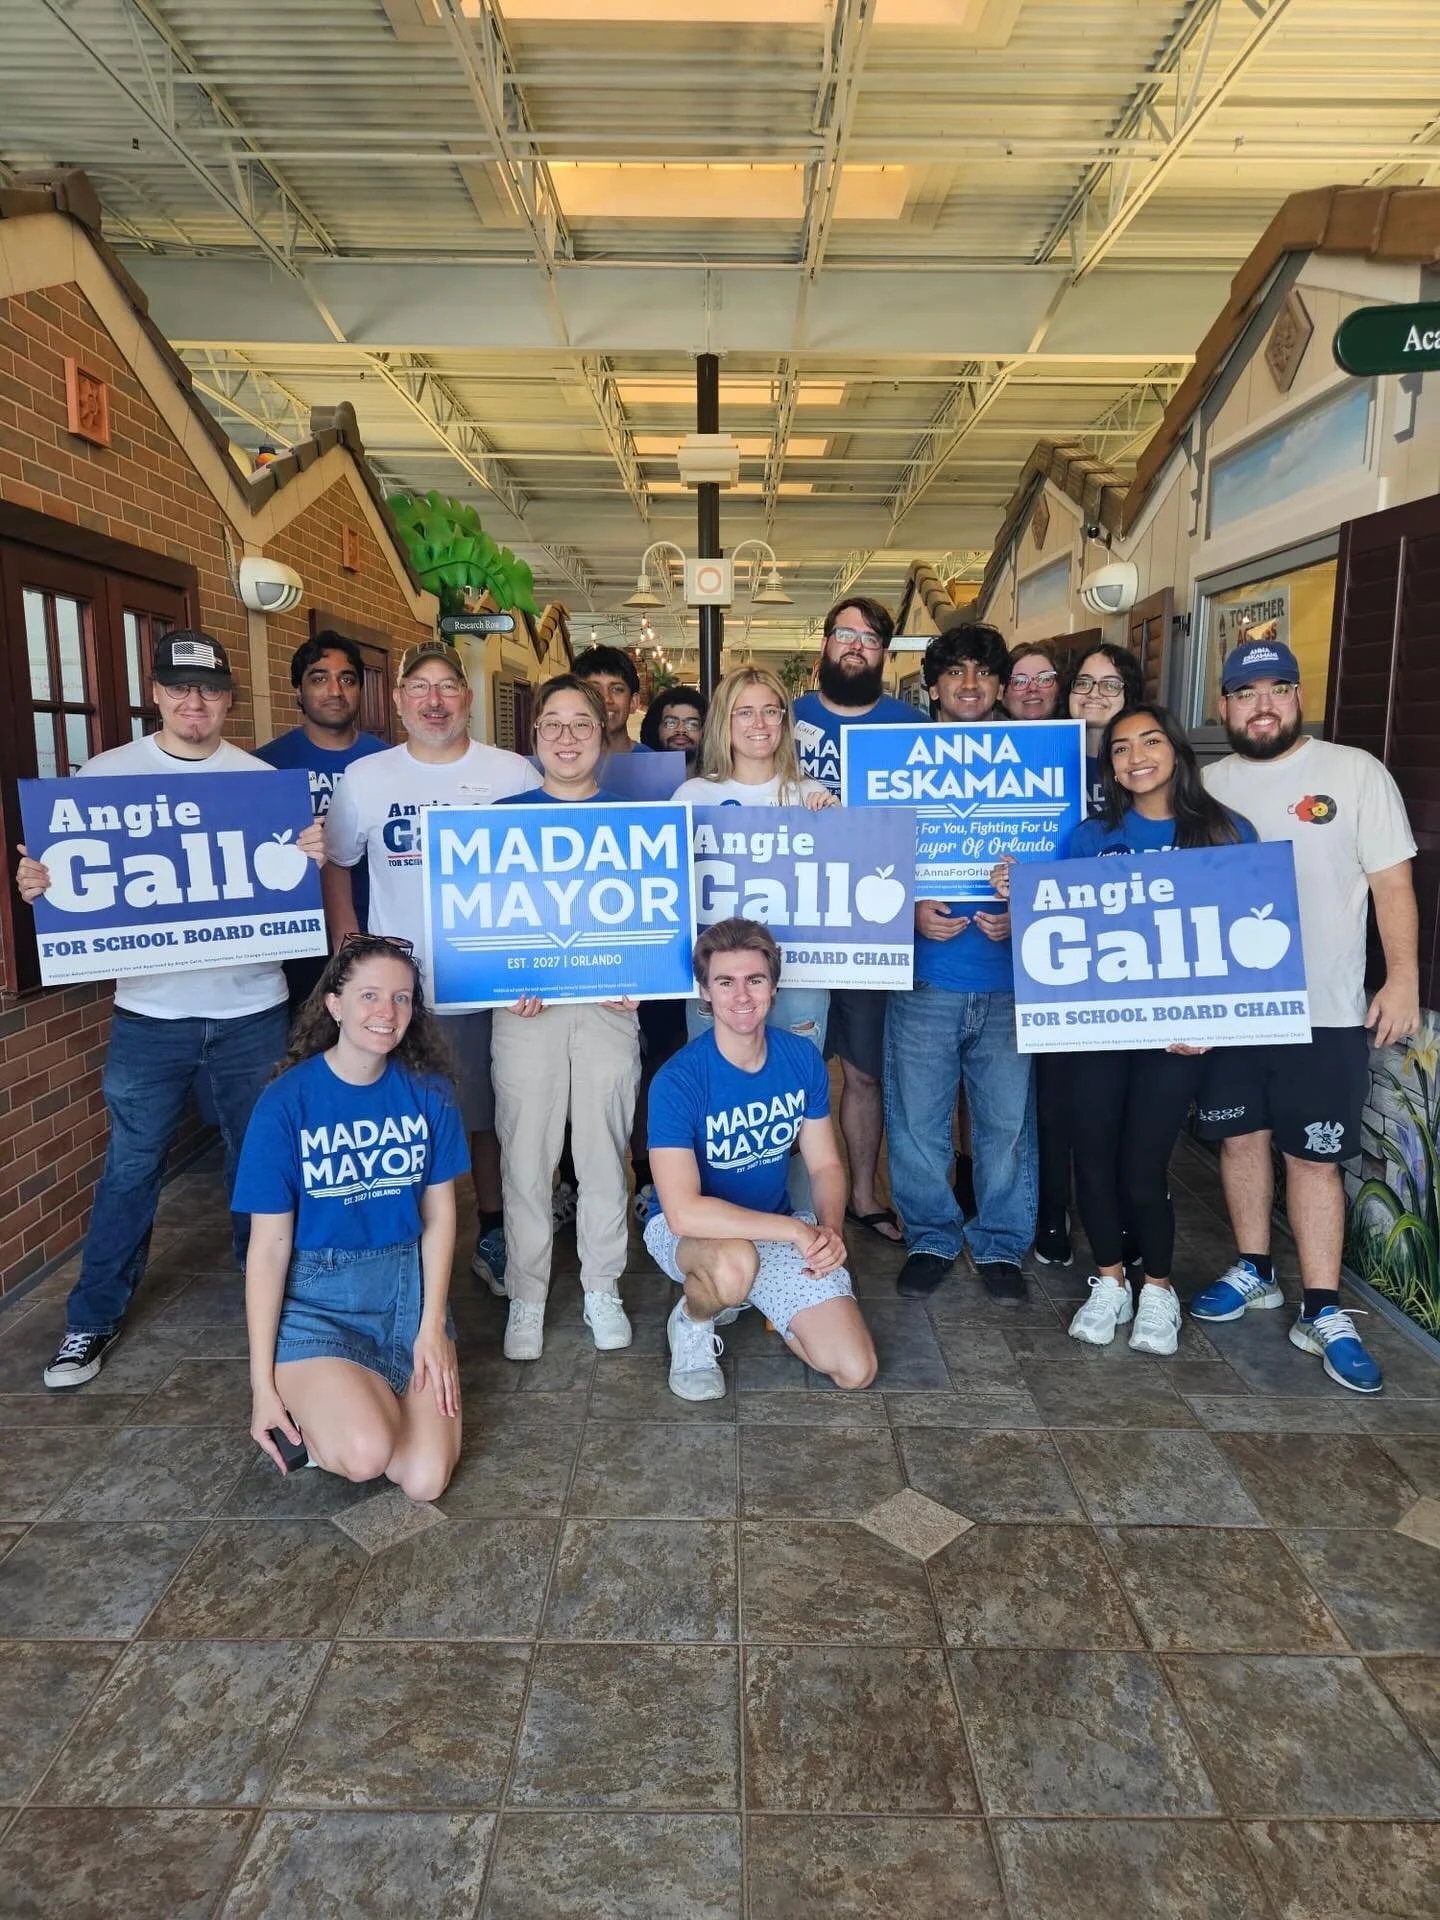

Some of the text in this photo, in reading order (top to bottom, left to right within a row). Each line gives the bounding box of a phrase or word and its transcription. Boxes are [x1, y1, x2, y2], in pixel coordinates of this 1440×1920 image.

[455, 621, 484, 630] Research
[1230, 598, 1284, 628] TOGETHER
[906, 733, 1022, 765] ANNA
[867, 767, 1065, 800] ESKAMANI
[49, 795, 200, 838] Angie
[921, 823, 941, 834] For
[943, 823, 967, 836] You,
[970, 822, 1018, 836] Fighting
[1021, 821, 1040, 833] For
[1043, 820, 1059, 832] Us
[439, 824, 678, 875] MADAM
[694, 825, 815, 863] Angie
[916, 836, 1056, 859] ayor Of Orlando
[441, 877, 681, 929] MAYOR
[1032, 872, 1175, 914] Angie
[42, 918, 321, 958] FOR SCHOOL BOARD CHAIR
[507, 954, 622, 969] EST. 2027 ORLANDO
[786, 950, 910, 966] BOARD CHAIR
[1021, 1000, 1305, 1027] FOR SCHOOL BOARD CHAIR
[706, 1089, 805, 1140] MADAM
[300, 1113, 428, 1158] MADAM
[302, 1144, 427, 1189] MAYOR
